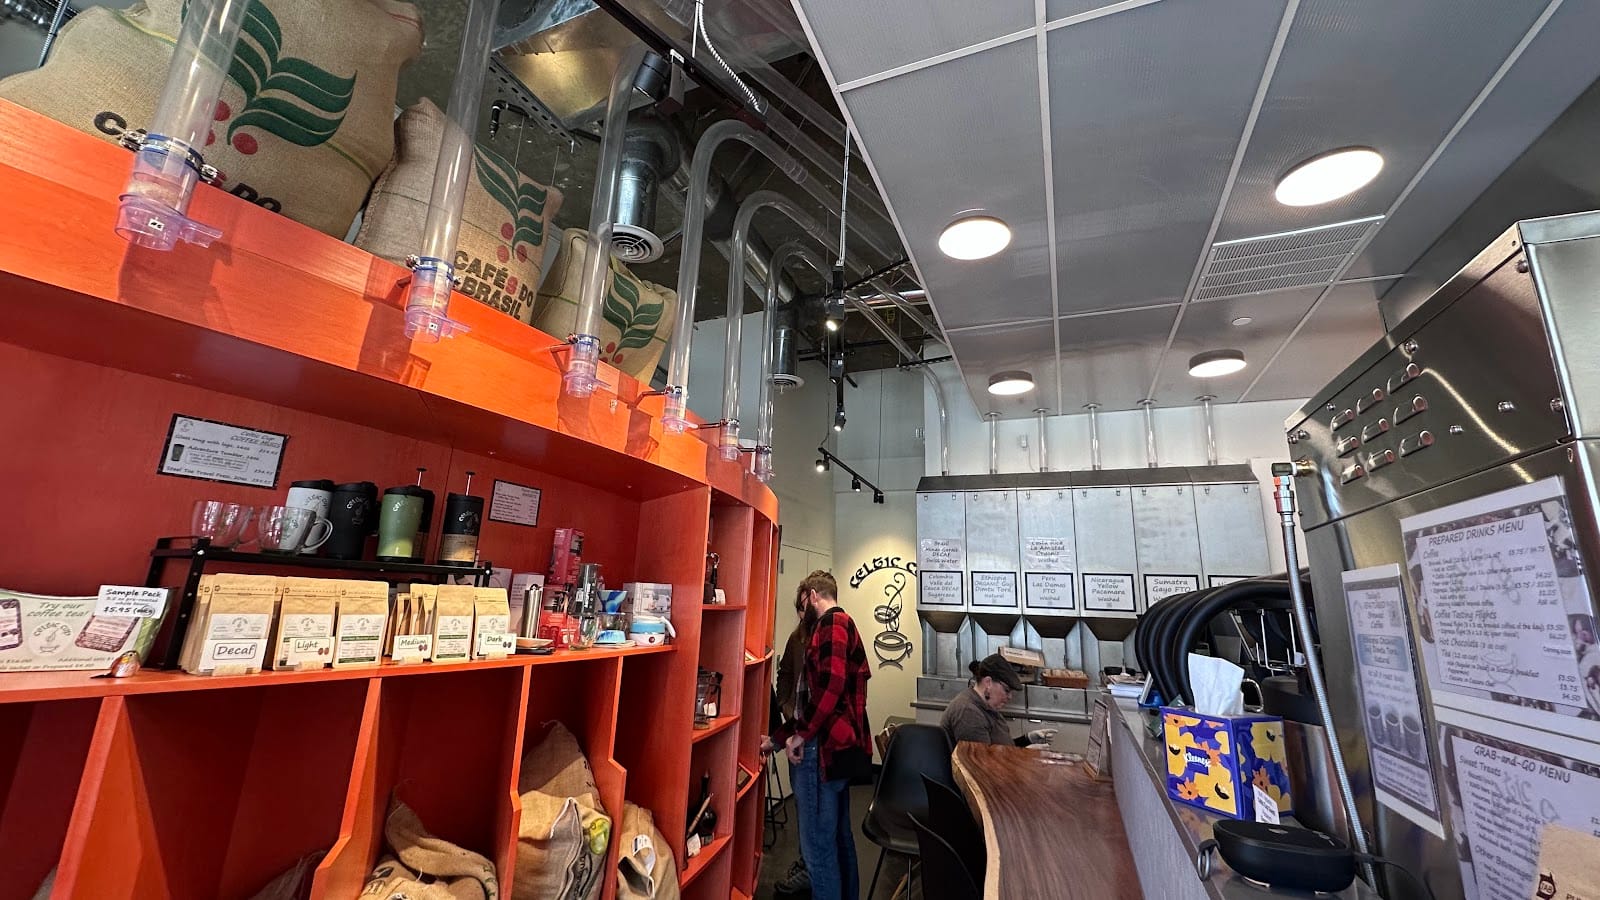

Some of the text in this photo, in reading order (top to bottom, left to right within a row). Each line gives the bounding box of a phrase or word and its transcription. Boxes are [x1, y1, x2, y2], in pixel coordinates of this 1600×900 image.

[454, 250, 534, 307] CAFÉS DO
[460, 276, 521, 320] BRASIL
[1428, 519, 1525, 547] PREPARED DRINKS MENU
[850, 556, 901, 589] CELTIC
[1090, 577, 1125, 585] Nicaragua
[105, 588, 140, 598] Sample
[142, 590, 162, 598] Pack
[1152, 586, 1172, 594] Gayo
[39, 602, 62, 612] Try
[103, 605, 132, 613] $5.95
[1434, 610, 1497, 623] Coffee Tasting Flights
[297, 640, 319, 651] Light
[400, 638, 426, 646] Medium
[1439, 637, 1450, 646] Hot
[1450, 637, 1479, 649] Chocolate
[217, 645, 256, 656] Decaf
[1442, 649, 1451, 658] Tea
[1459, 755, 1502, 777] Sweet Treats
[1473, 745, 1572, 784] GRAB-and-GO MENU
[1474, 844, 1495, 860] Other
[1540, 881, 1552, 894] TAB
